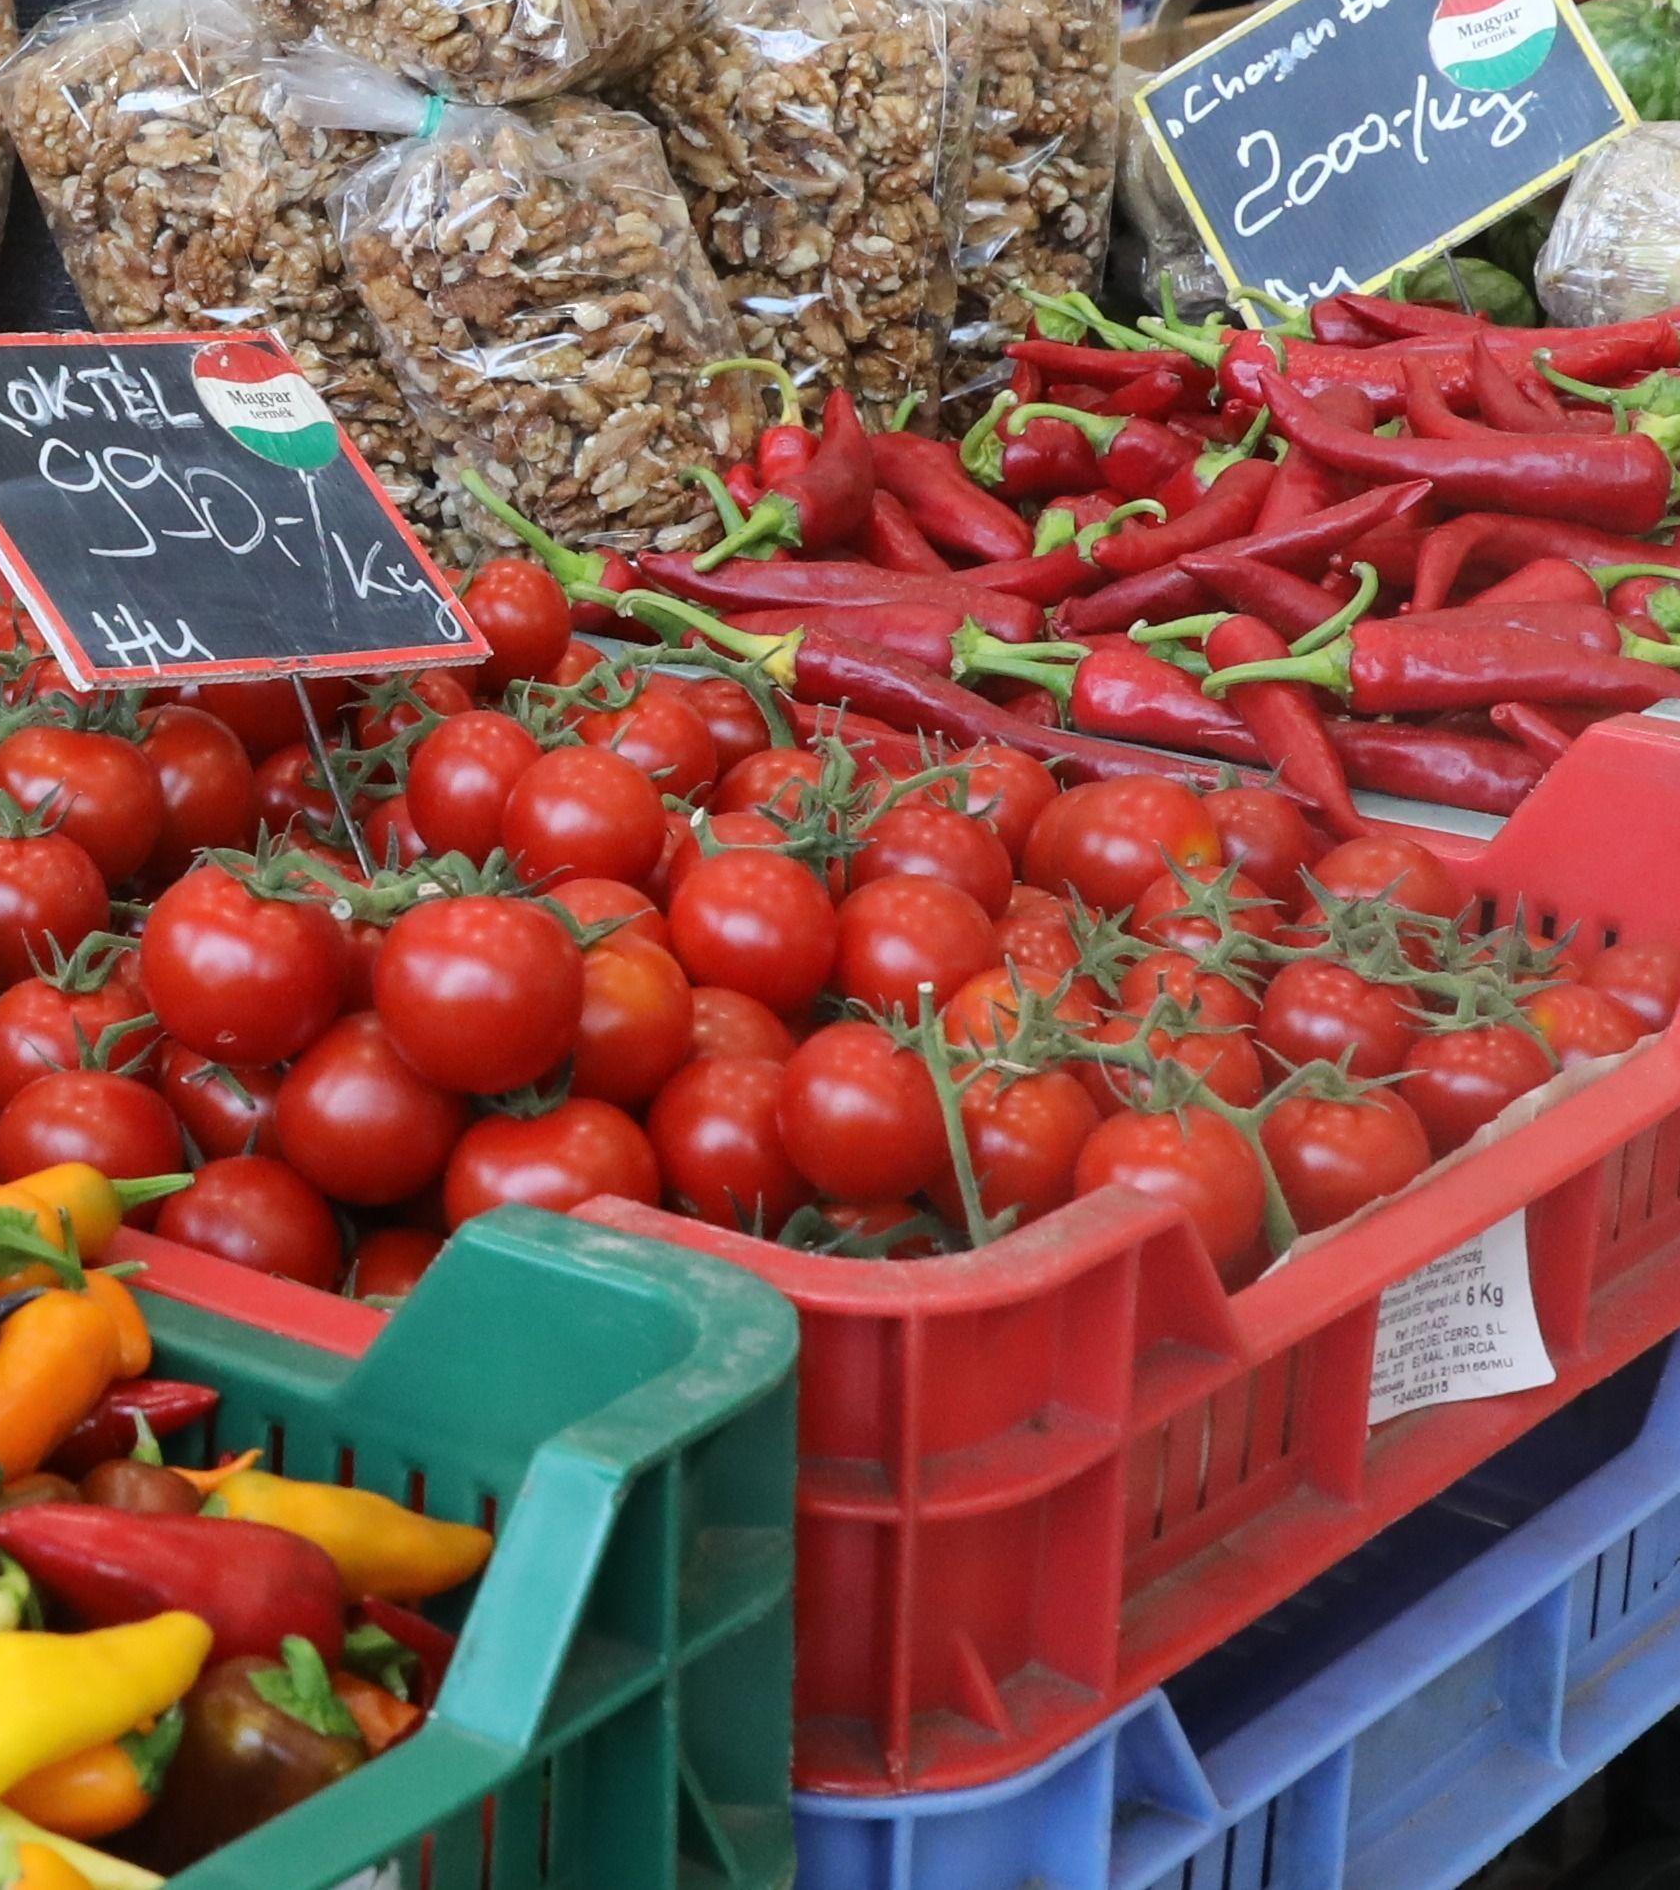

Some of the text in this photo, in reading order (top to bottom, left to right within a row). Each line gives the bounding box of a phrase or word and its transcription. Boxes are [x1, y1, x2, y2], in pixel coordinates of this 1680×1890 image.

[1457, 4, 1523, 41] Magyar
[1471, 26, 1518, 51] termék
[226, 386, 293, 410] Magyar
[247, 405, 295, 422] termék
[1466, 1265, 1486, 1282] KFT
[1466, 1286, 1475, 1306] 6
[1480, 1282, 1504, 1308] Kg
[1451, 1341, 1497, 1359] MURCIA
